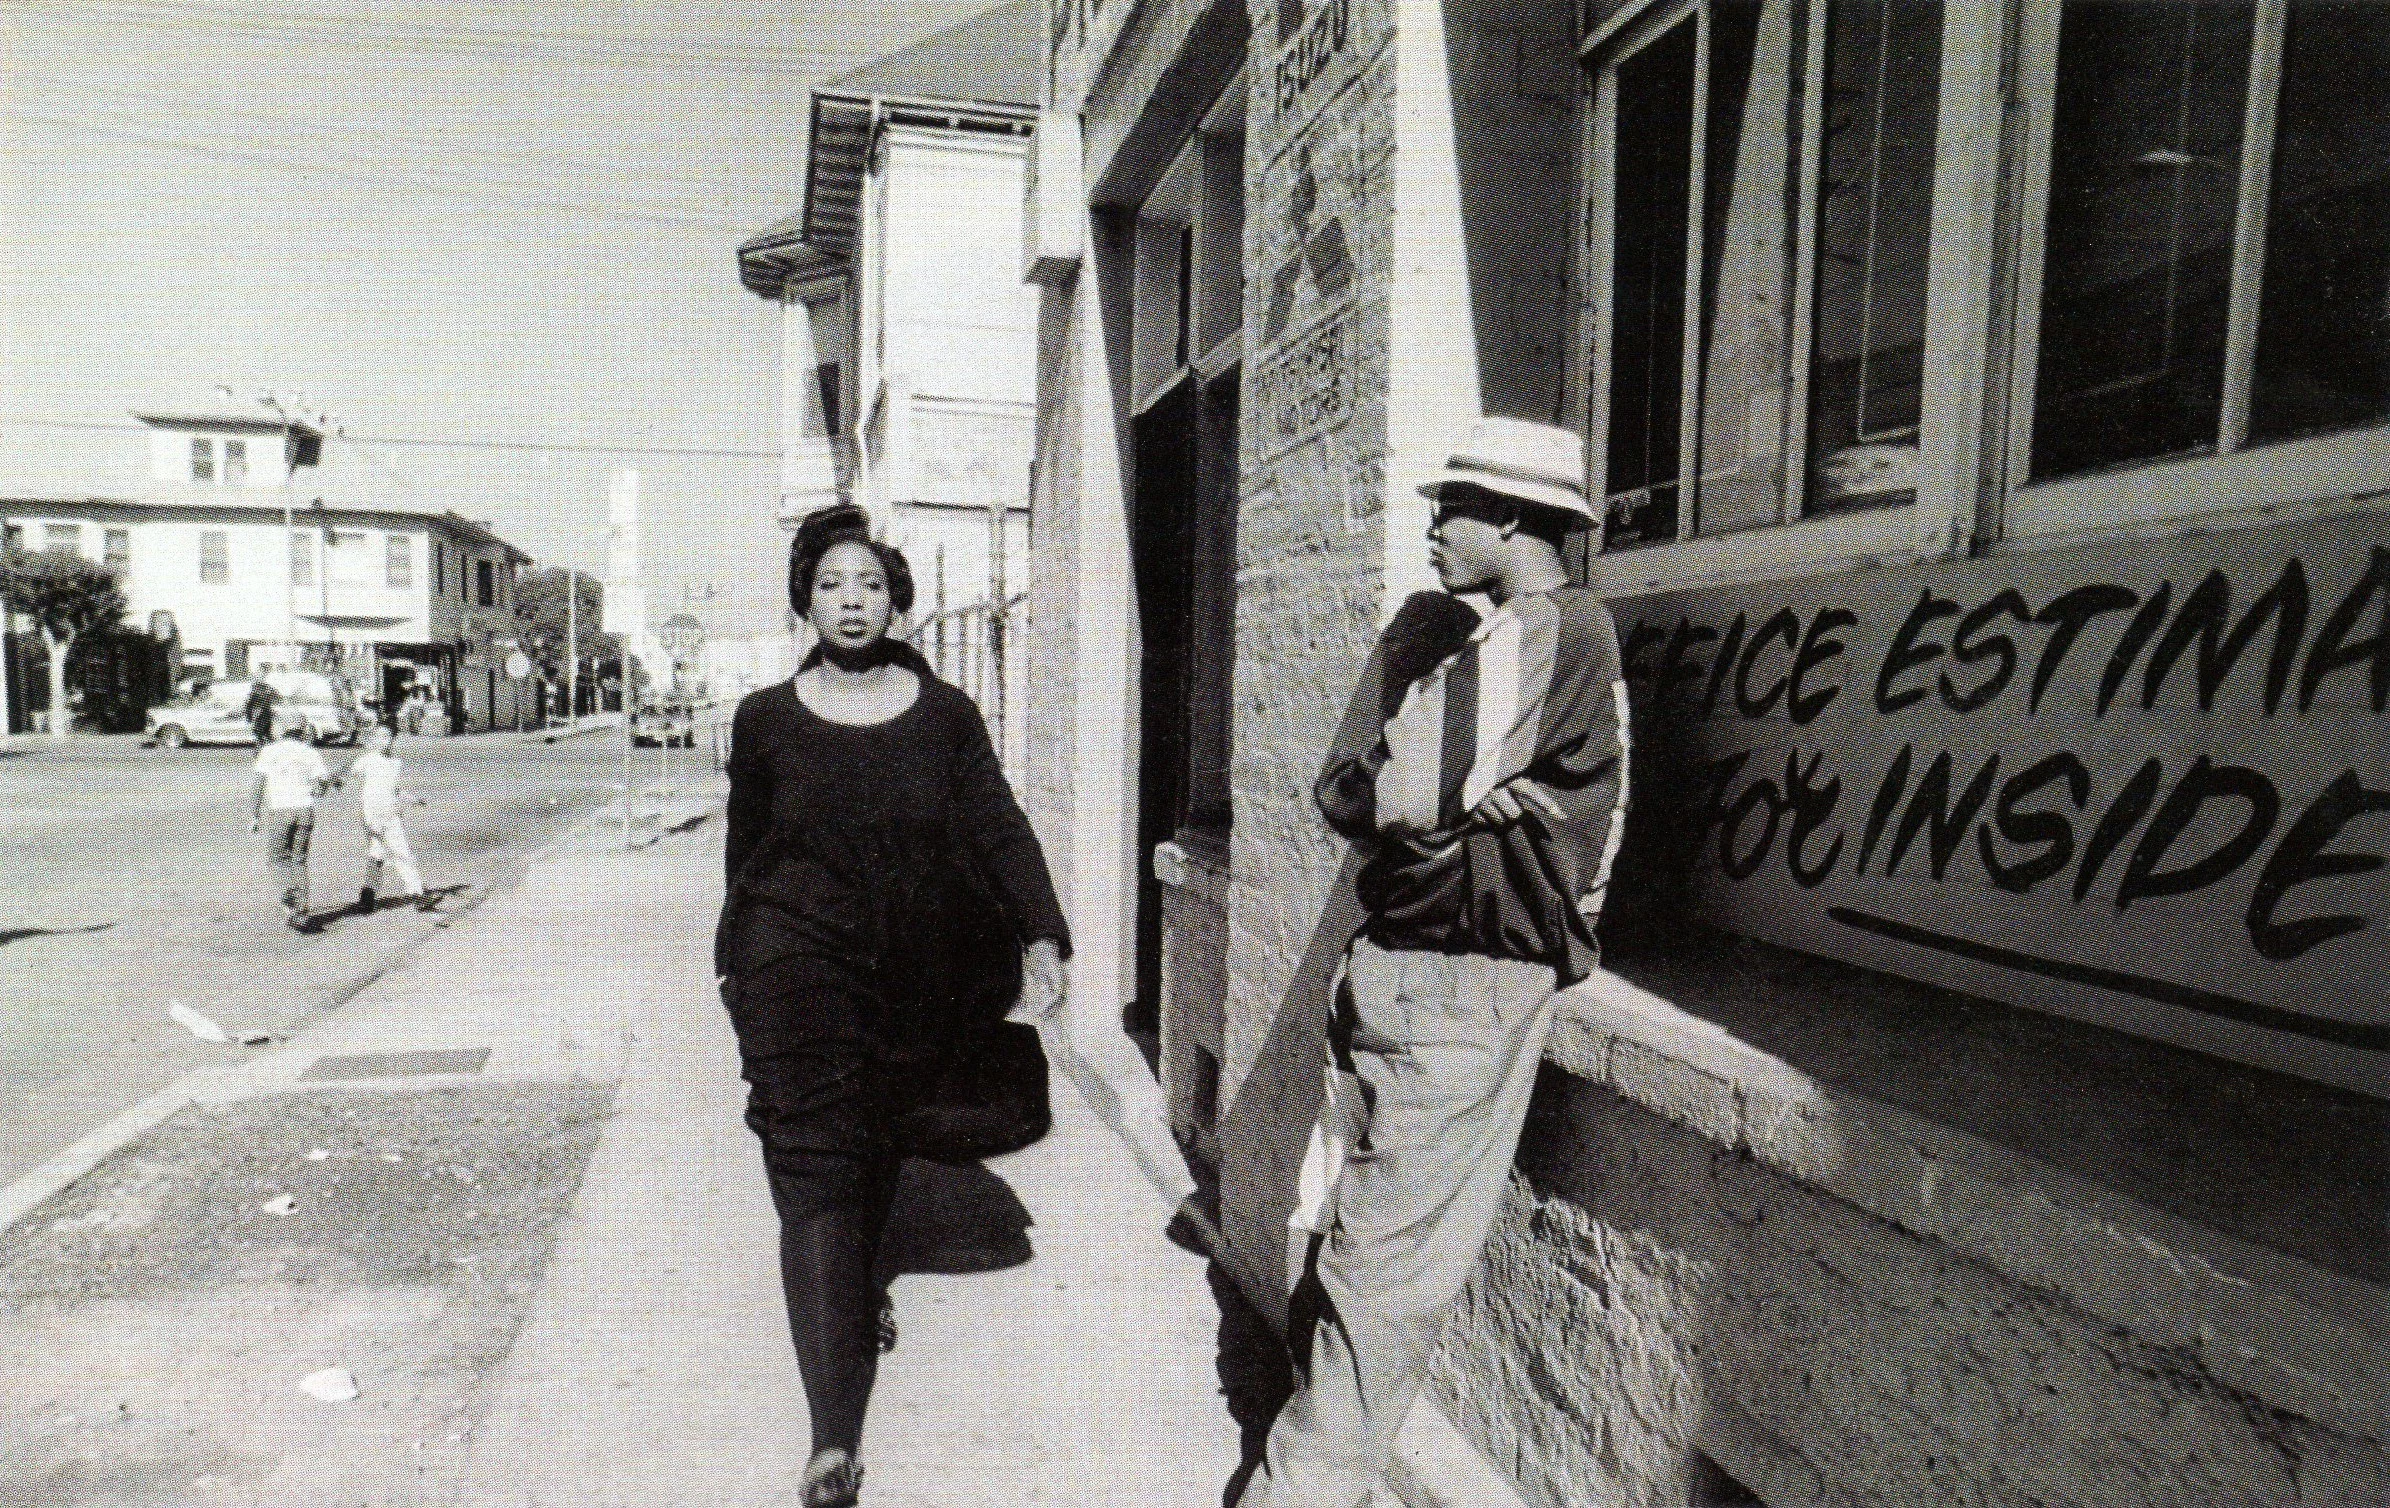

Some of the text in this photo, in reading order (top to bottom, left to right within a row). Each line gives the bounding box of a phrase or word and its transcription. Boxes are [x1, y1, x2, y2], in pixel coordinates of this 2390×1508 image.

[1274, 0, 1349, 118] ISUZU
[1622, 604, 1859, 723] FFICE
[1857, 742, 2390, 961] INSIDE
